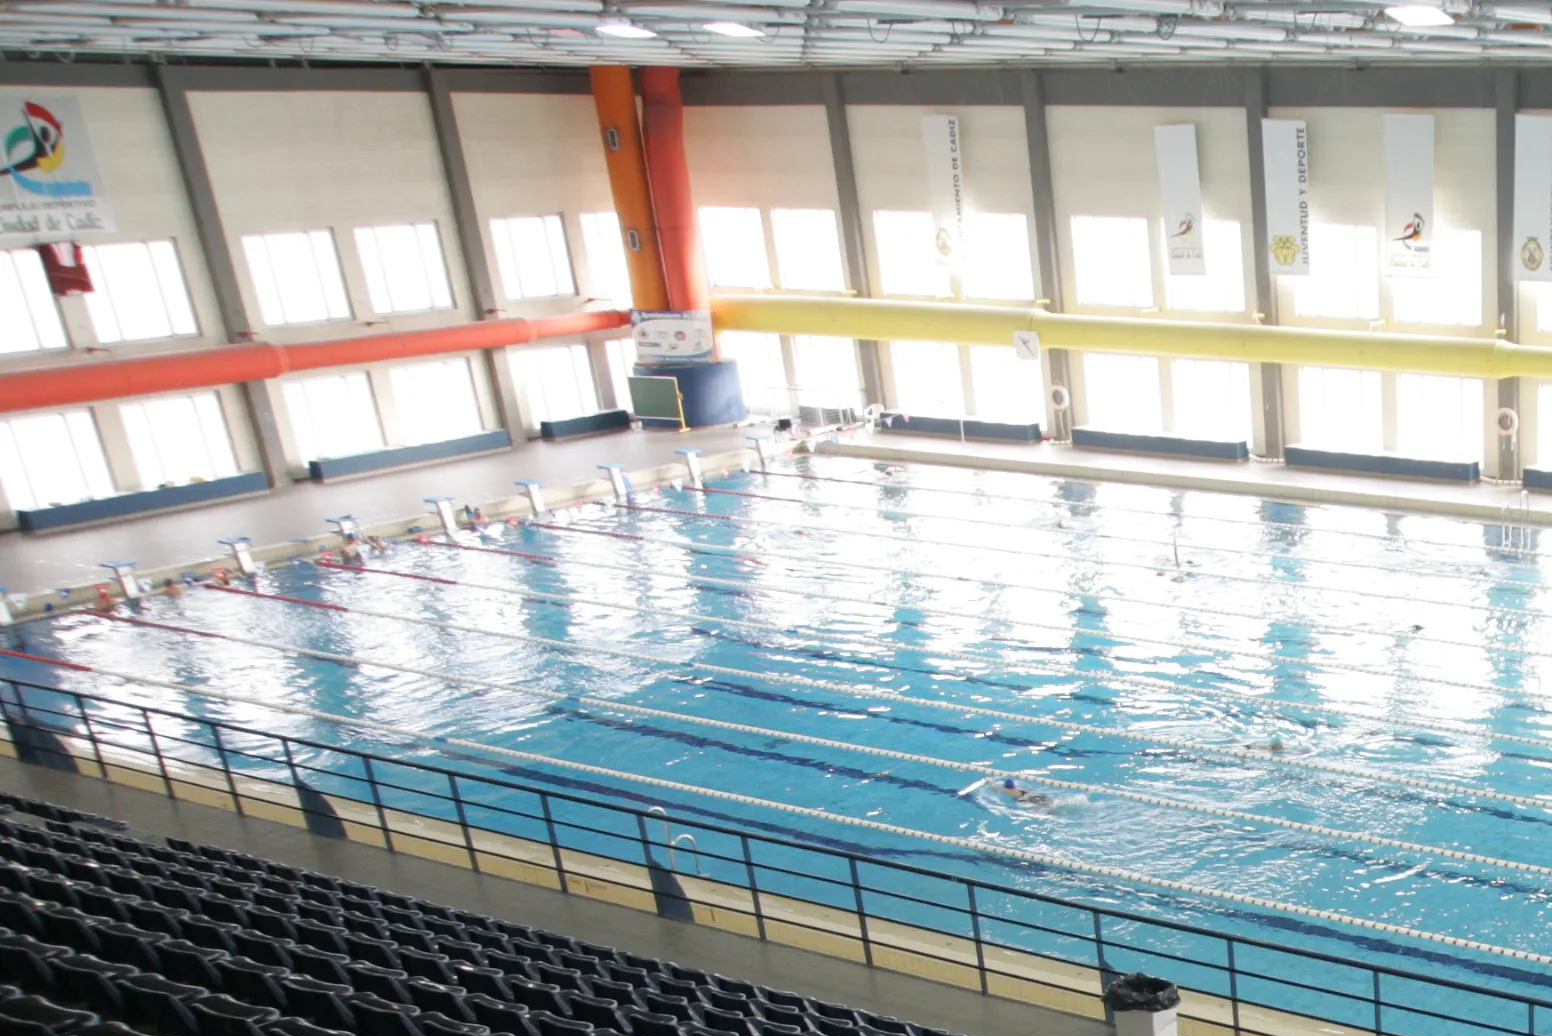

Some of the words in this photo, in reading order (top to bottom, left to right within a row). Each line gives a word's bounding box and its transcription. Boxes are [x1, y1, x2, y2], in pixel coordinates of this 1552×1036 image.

[948, 119, 957, 153] CADIZ
[951, 157, 959, 170] DE
[1296, 127, 1307, 183] DEPORTE
[1298, 188, 1307, 196] Y
[1300, 200, 1309, 266] JUVENTUD
